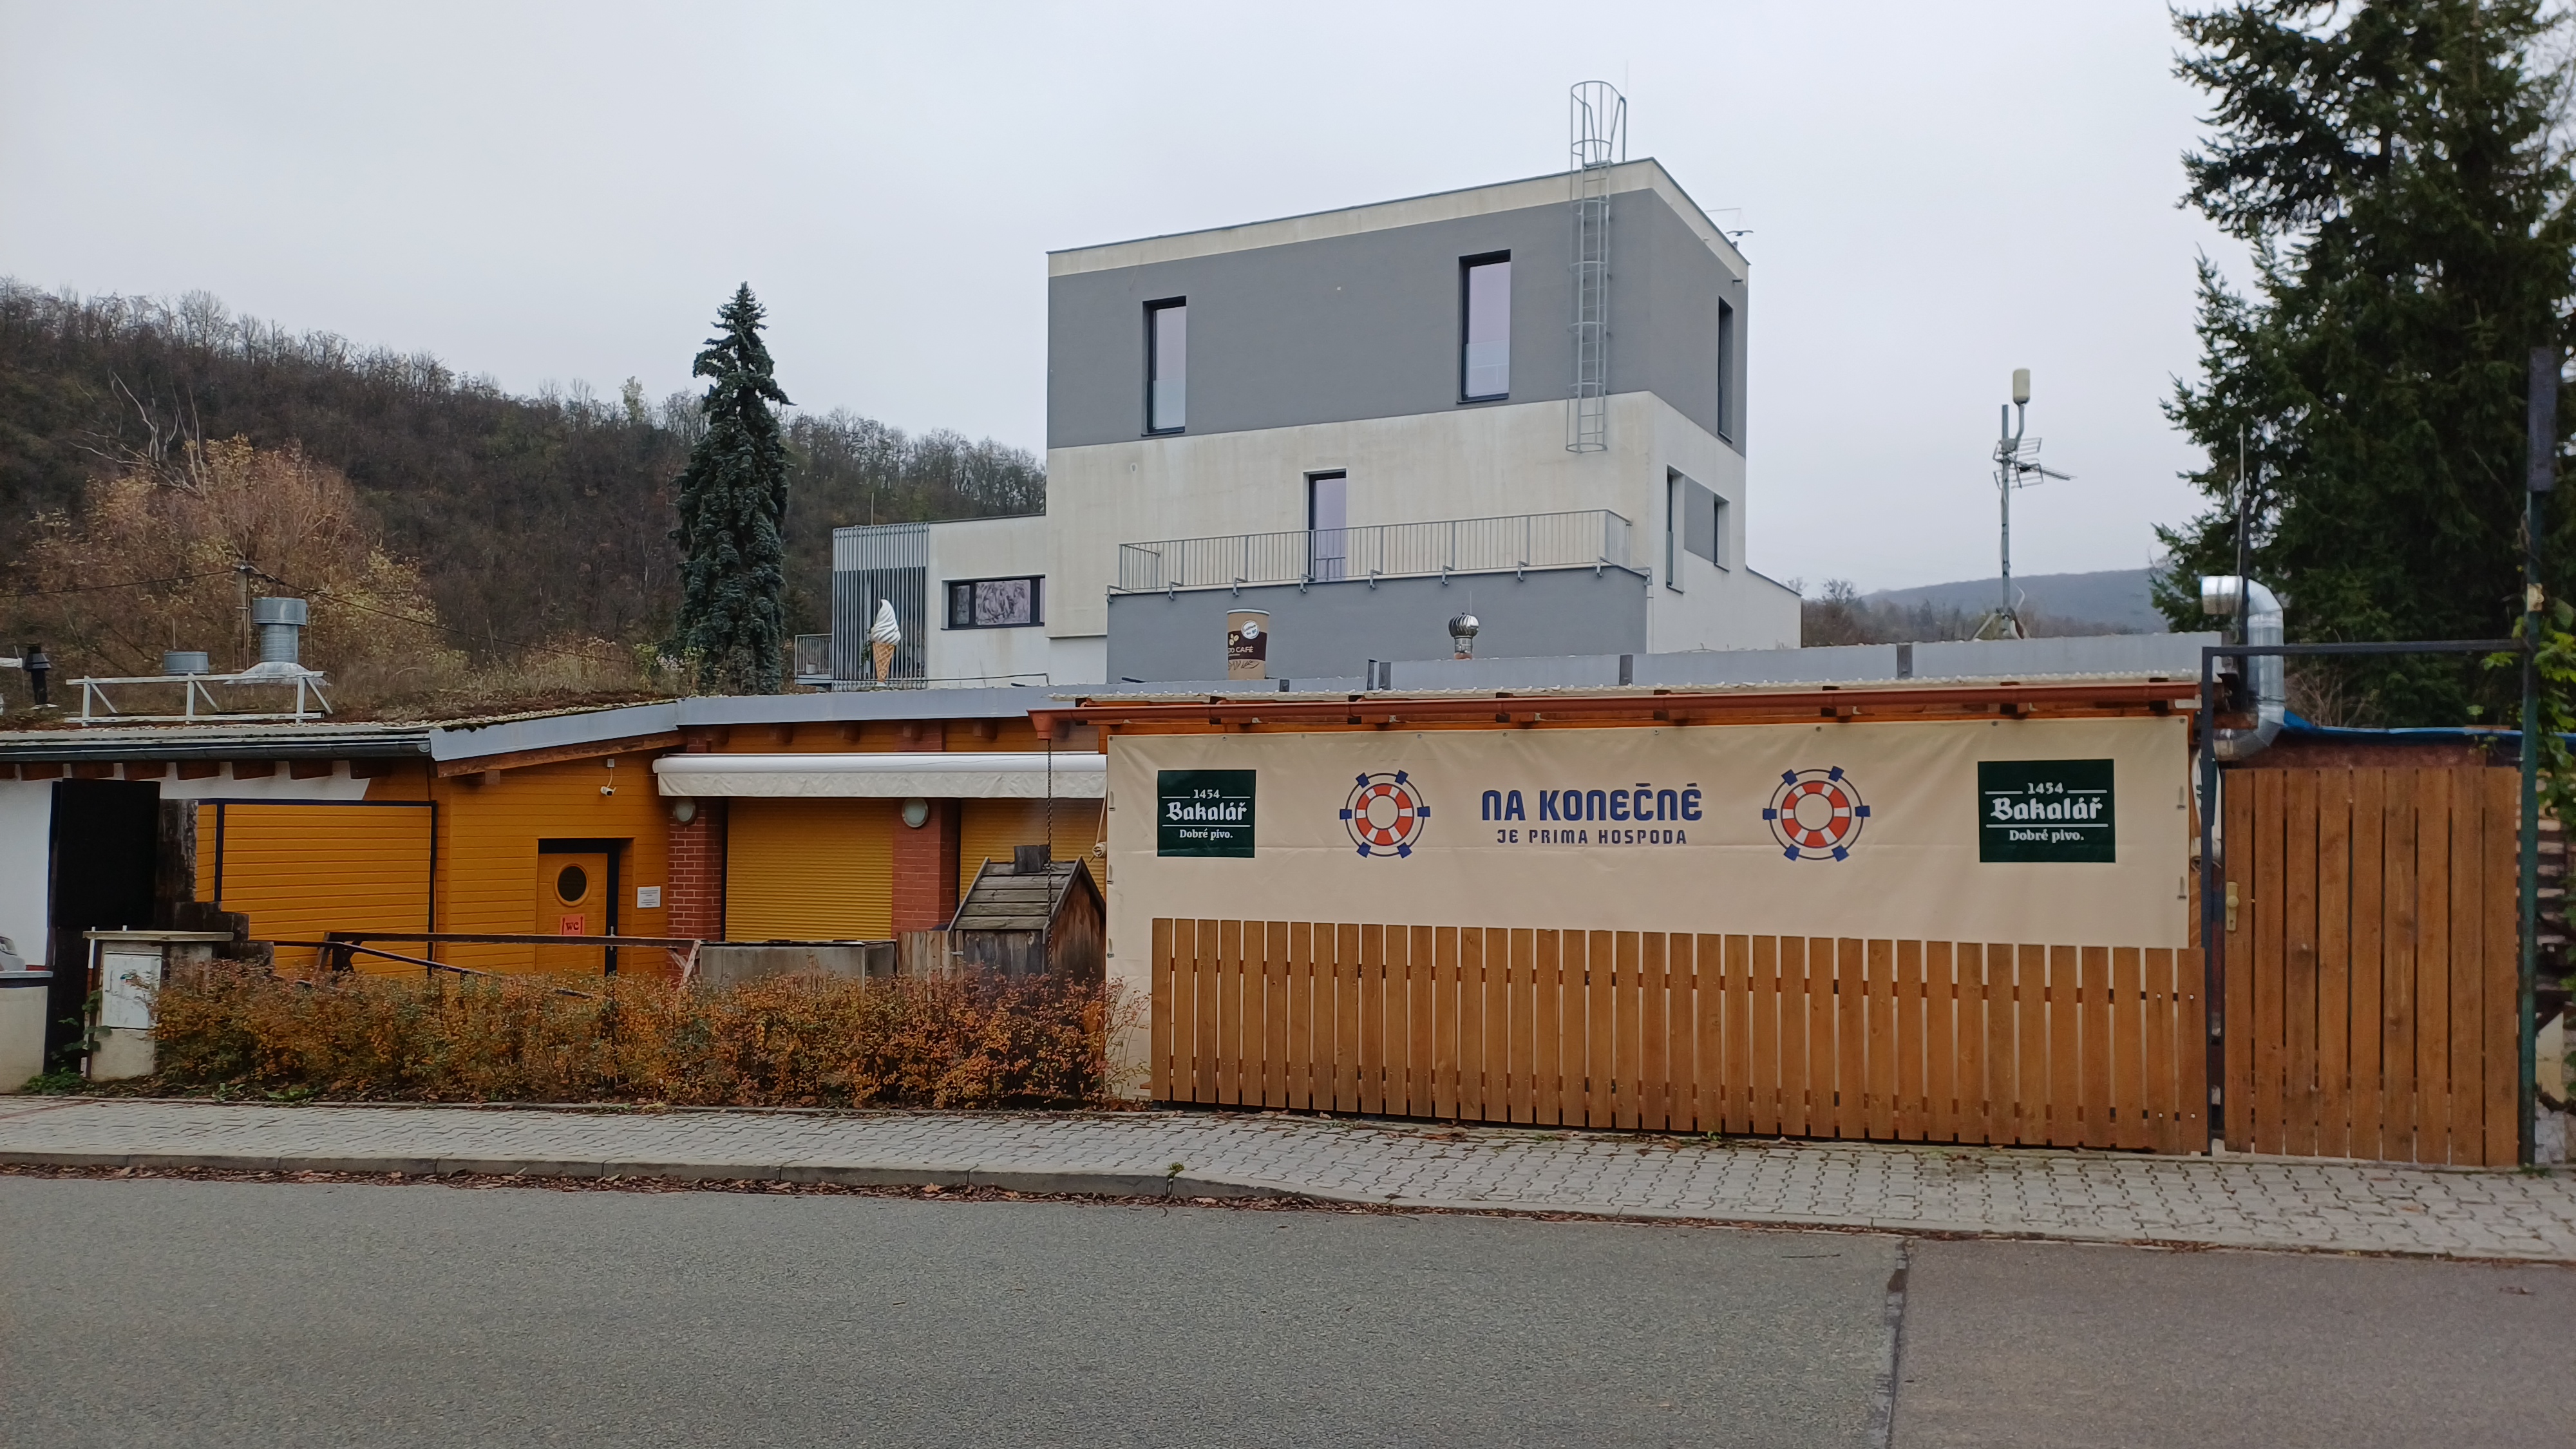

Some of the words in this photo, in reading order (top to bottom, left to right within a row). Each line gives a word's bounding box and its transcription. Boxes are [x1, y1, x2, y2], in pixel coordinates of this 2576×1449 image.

[1193, 789, 1220, 799] 1454
[2027, 782, 2064, 795] 1454
[1482, 790, 1526, 821] NA
[1539, 782, 1702, 821] KONEČNÉ
[1990, 797, 2103, 820] Bakalář
[1166, 801, 1247, 821] Bakalář
[1179, 828, 1208, 838] Dobré
[1497, 829, 1519, 844] JE
[1529, 829, 1587, 844] PRIMA
[1598, 829, 1687, 844] HOSPODA
[2009, 828, 2049, 841] Dobré
[2051, 829, 2084, 844] pivo.
[565, 922, 580, 931] WC
